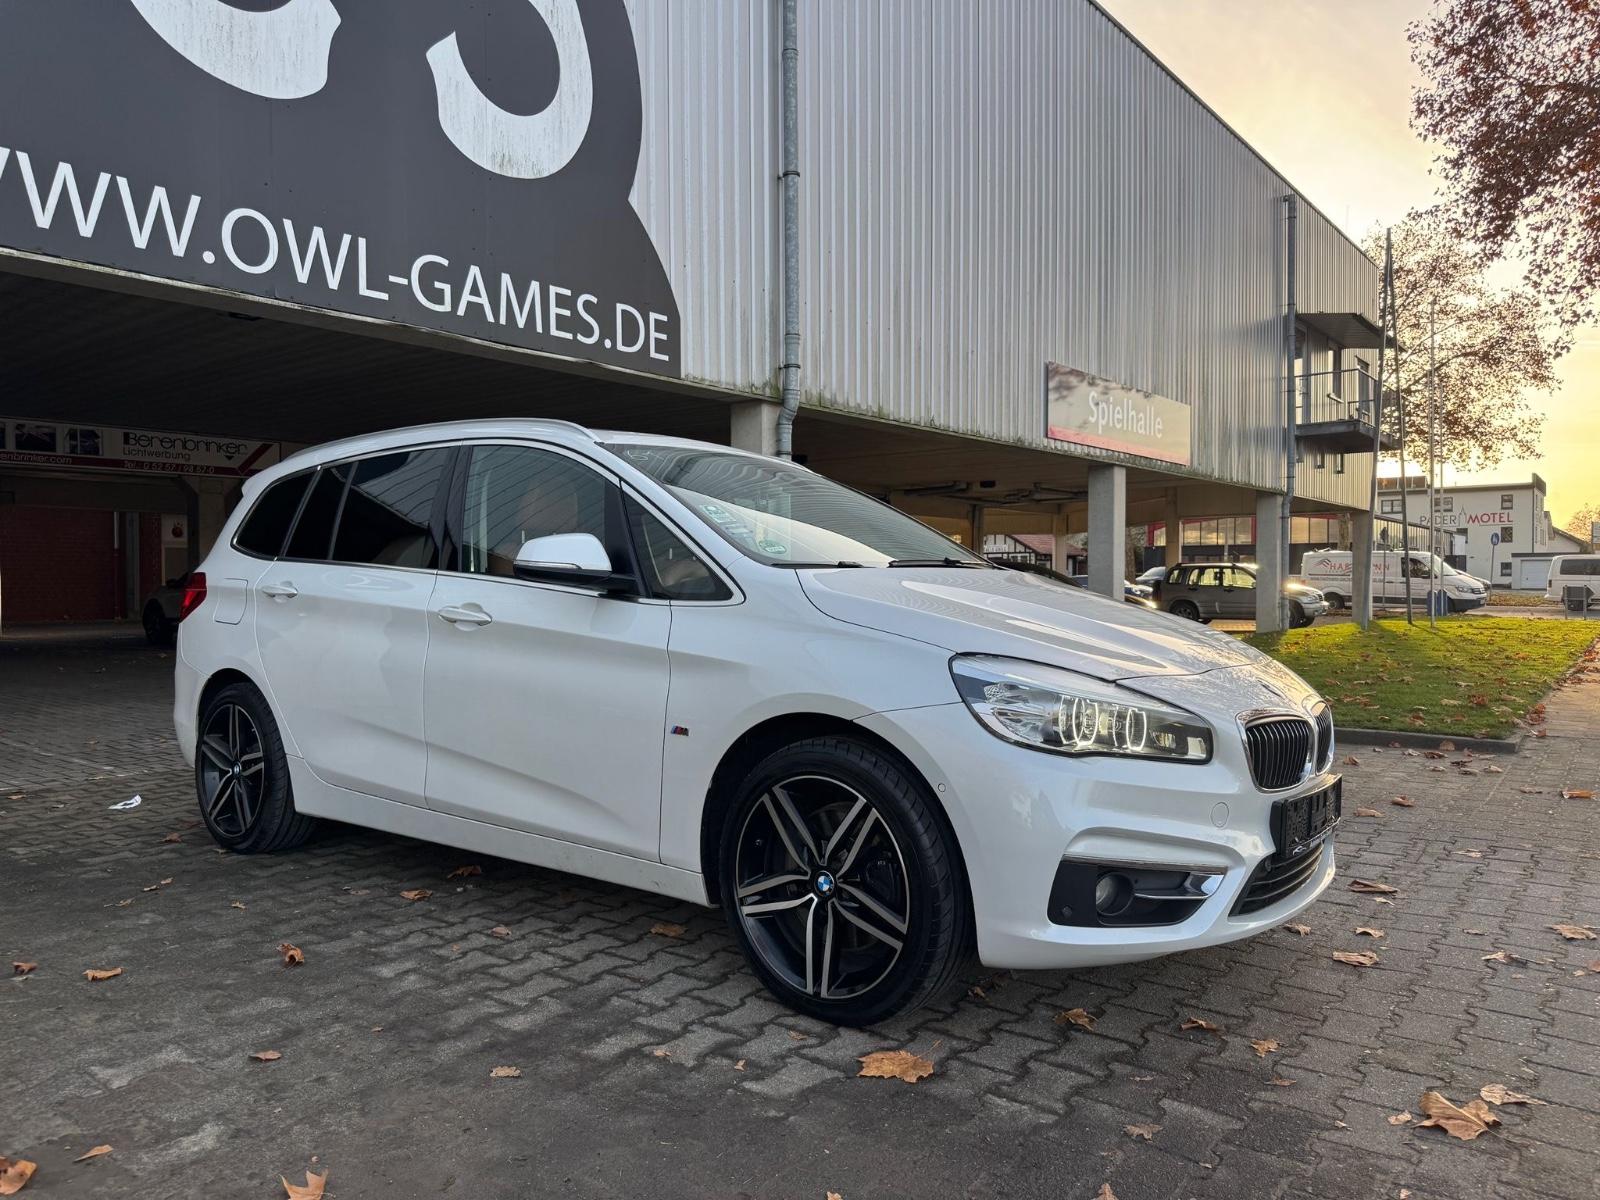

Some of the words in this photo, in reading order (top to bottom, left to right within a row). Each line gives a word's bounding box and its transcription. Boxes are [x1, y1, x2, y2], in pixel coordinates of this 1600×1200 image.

[0, 146, 670, 362] WW.OWL-GAMES.DE
[1088, 390, 1164, 439] Spielhalle
[122, 447, 191, 461] Lichtwerbung
[1467, 512, 1513, 524] MOTEL
